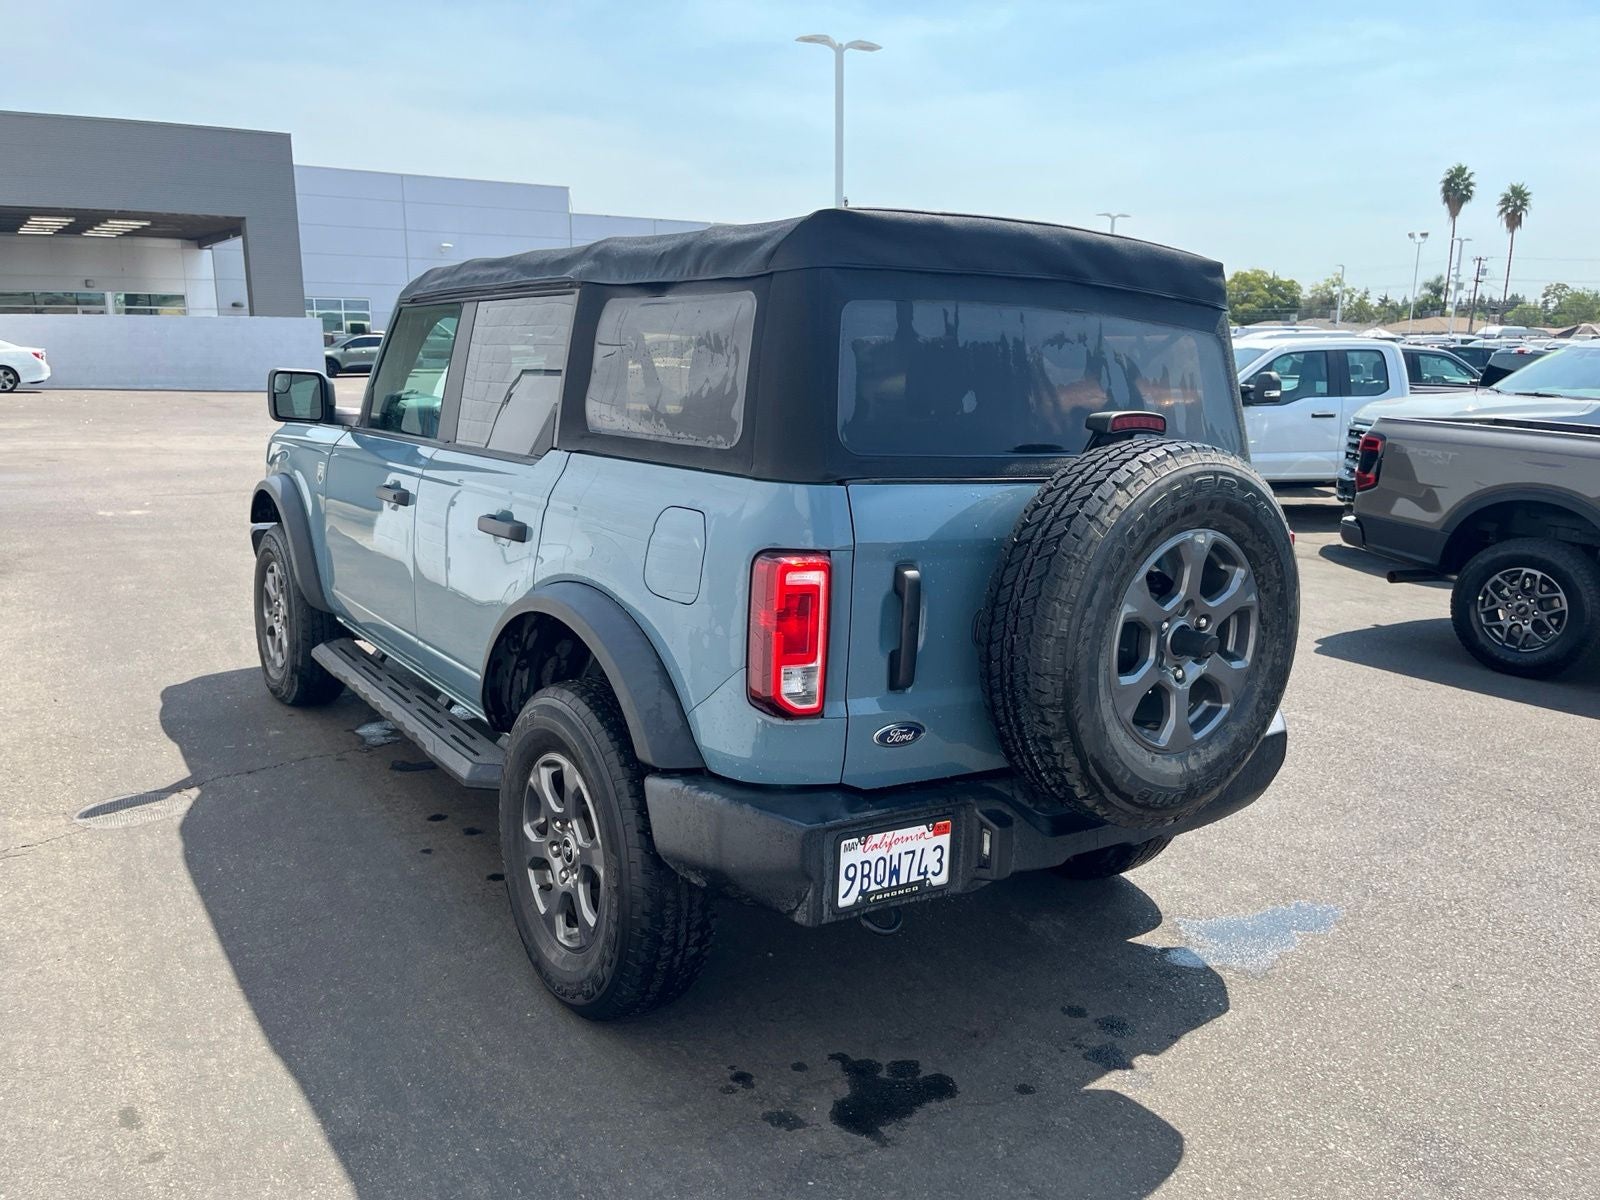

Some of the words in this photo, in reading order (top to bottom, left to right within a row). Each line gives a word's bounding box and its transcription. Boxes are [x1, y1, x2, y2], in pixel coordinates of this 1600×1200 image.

[886, 728, 915, 744] Ford
[843, 841, 859, 853] MAY
[862, 829, 934, 853] California
[842, 844, 945, 899] 9BQW743
[876, 885, 920, 900] BRONCO
